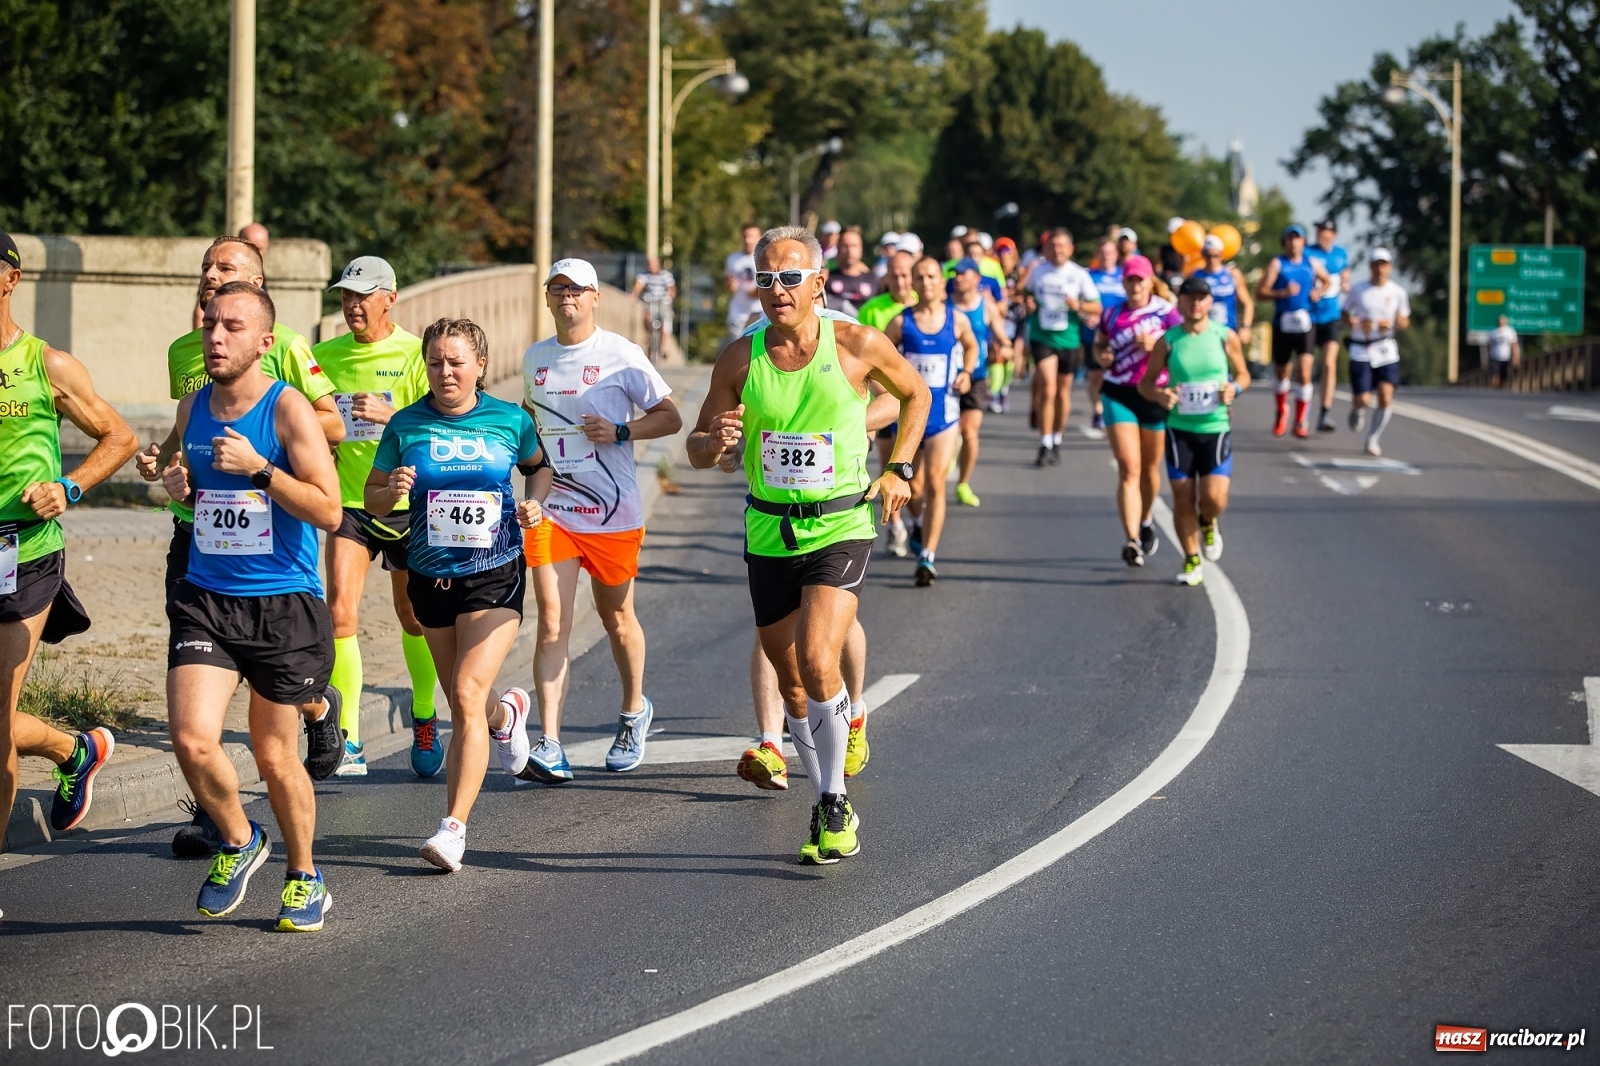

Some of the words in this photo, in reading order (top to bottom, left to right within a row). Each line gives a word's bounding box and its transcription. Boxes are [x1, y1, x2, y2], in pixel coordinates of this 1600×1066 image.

[557, 437, 565, 458] 1
[780, 448, 815, 467] 382
[441, 464, 483, 472] RACIBÓRZ
[212, 508, 250, 529] 206
[449, 506, 486, 525] 463
